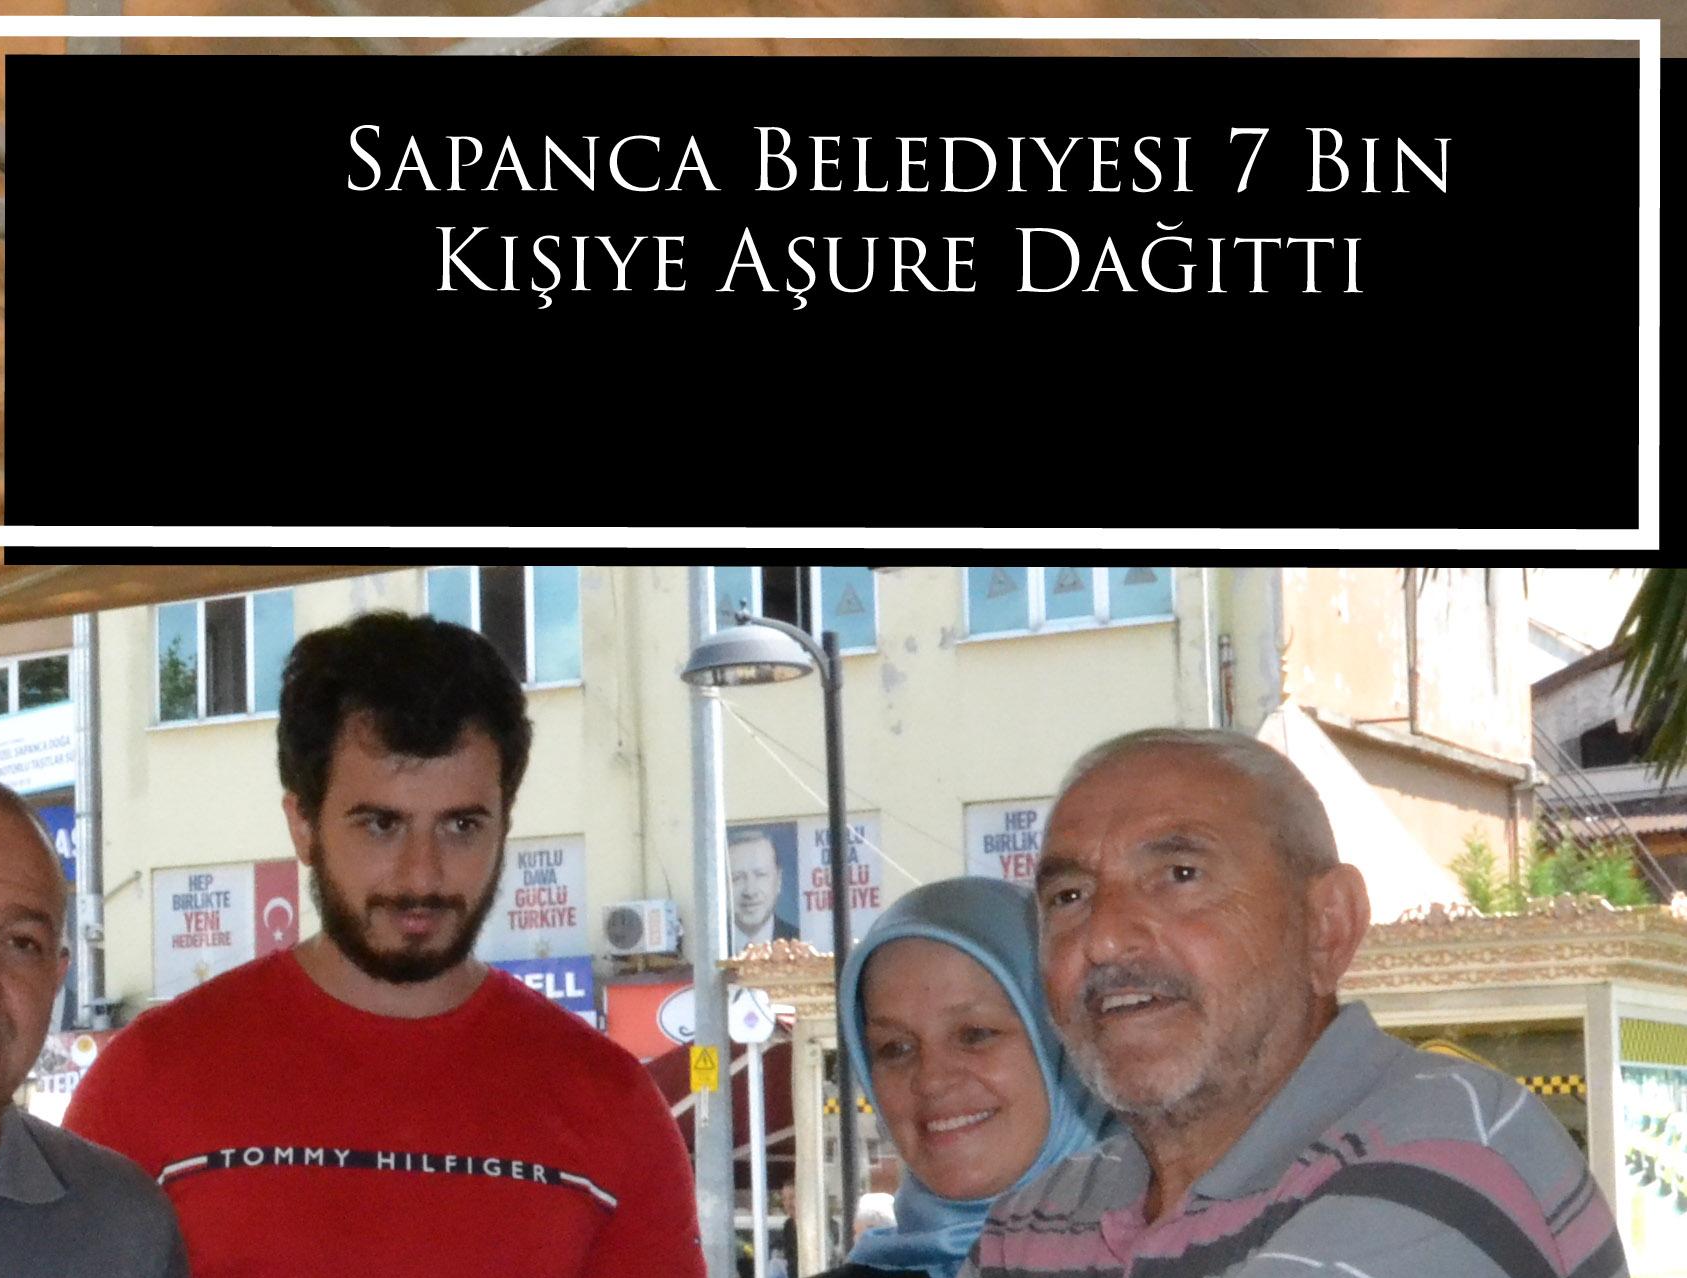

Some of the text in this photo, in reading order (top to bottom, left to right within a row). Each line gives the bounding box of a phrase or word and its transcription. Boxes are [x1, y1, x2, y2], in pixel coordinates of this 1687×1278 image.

[1005, 809, 1037, 831] HEP
[518, 849, 563, 869] KUTLU
[189, 874, 213, 892] HEP
[523, 868, 558, 886] DAVA
[172, 931, 231, 949] HEDEFLERE
[514, 972, 586, 998] ELL
[220, 1147, 548, 1183] TOMMY HILFIGER
